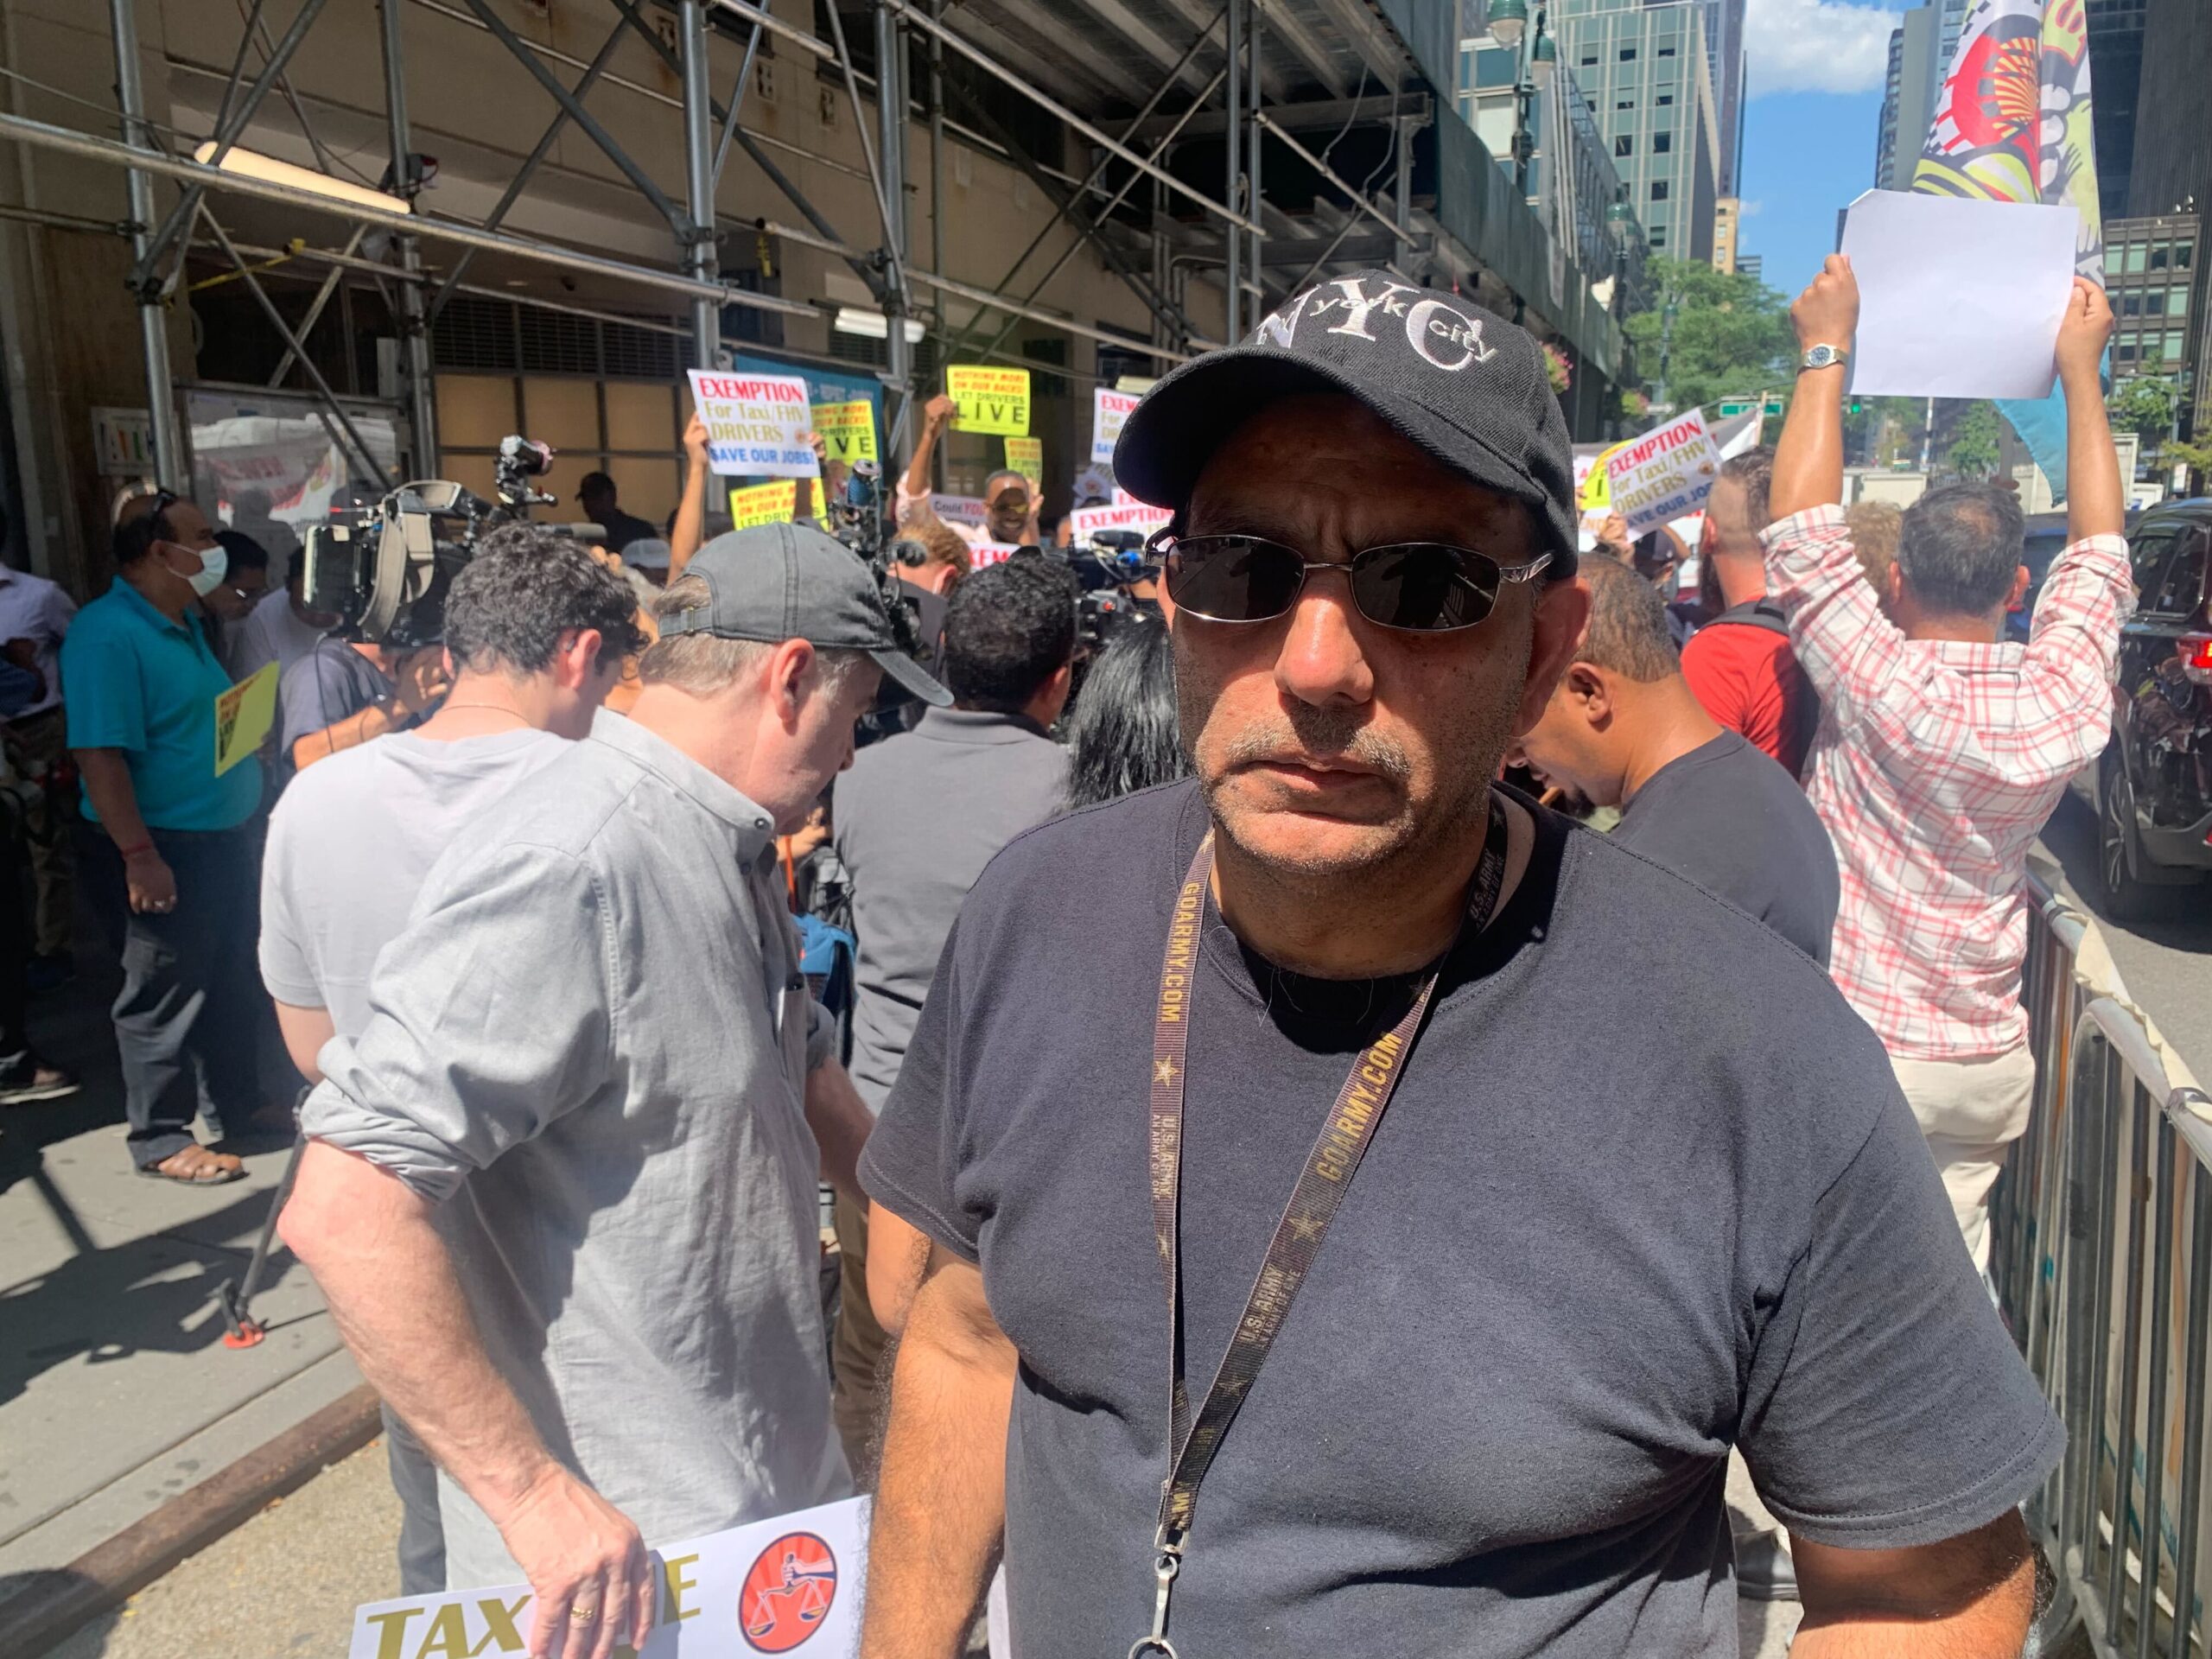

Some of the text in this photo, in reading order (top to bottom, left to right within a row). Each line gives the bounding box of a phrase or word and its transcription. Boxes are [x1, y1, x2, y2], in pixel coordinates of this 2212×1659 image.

[970, 381, 990, 391] OUR
[1000, 373, 1026, 383] MORE
[697, 377, 804, 404] EXEMPTION
[954, 391, 1025, 404] LET DRIVERS
[703, 400, 732, 418] For
[954, 401, 1026, 424] LIVE
[710, 422, 785, 443] DRIVERS
[709, 447, 749, 463] SAVE
[750, 448, 779, 462] OUR
[1608, 417, 1702, 479] EXEMPTION
[1611, 476, 1632, 496] For
[1614, 471, 1688, 514] DRIVERS
[1627, 508, 1653, 528] AVE
[1655, 495, 1688, 517] OUR
[1160, 881, 1200, 1022] GOARMY.COM
[1315, 1032, 1403, 1183] GOARMY.COM
[365, 1592, 535, 1659] TAX
